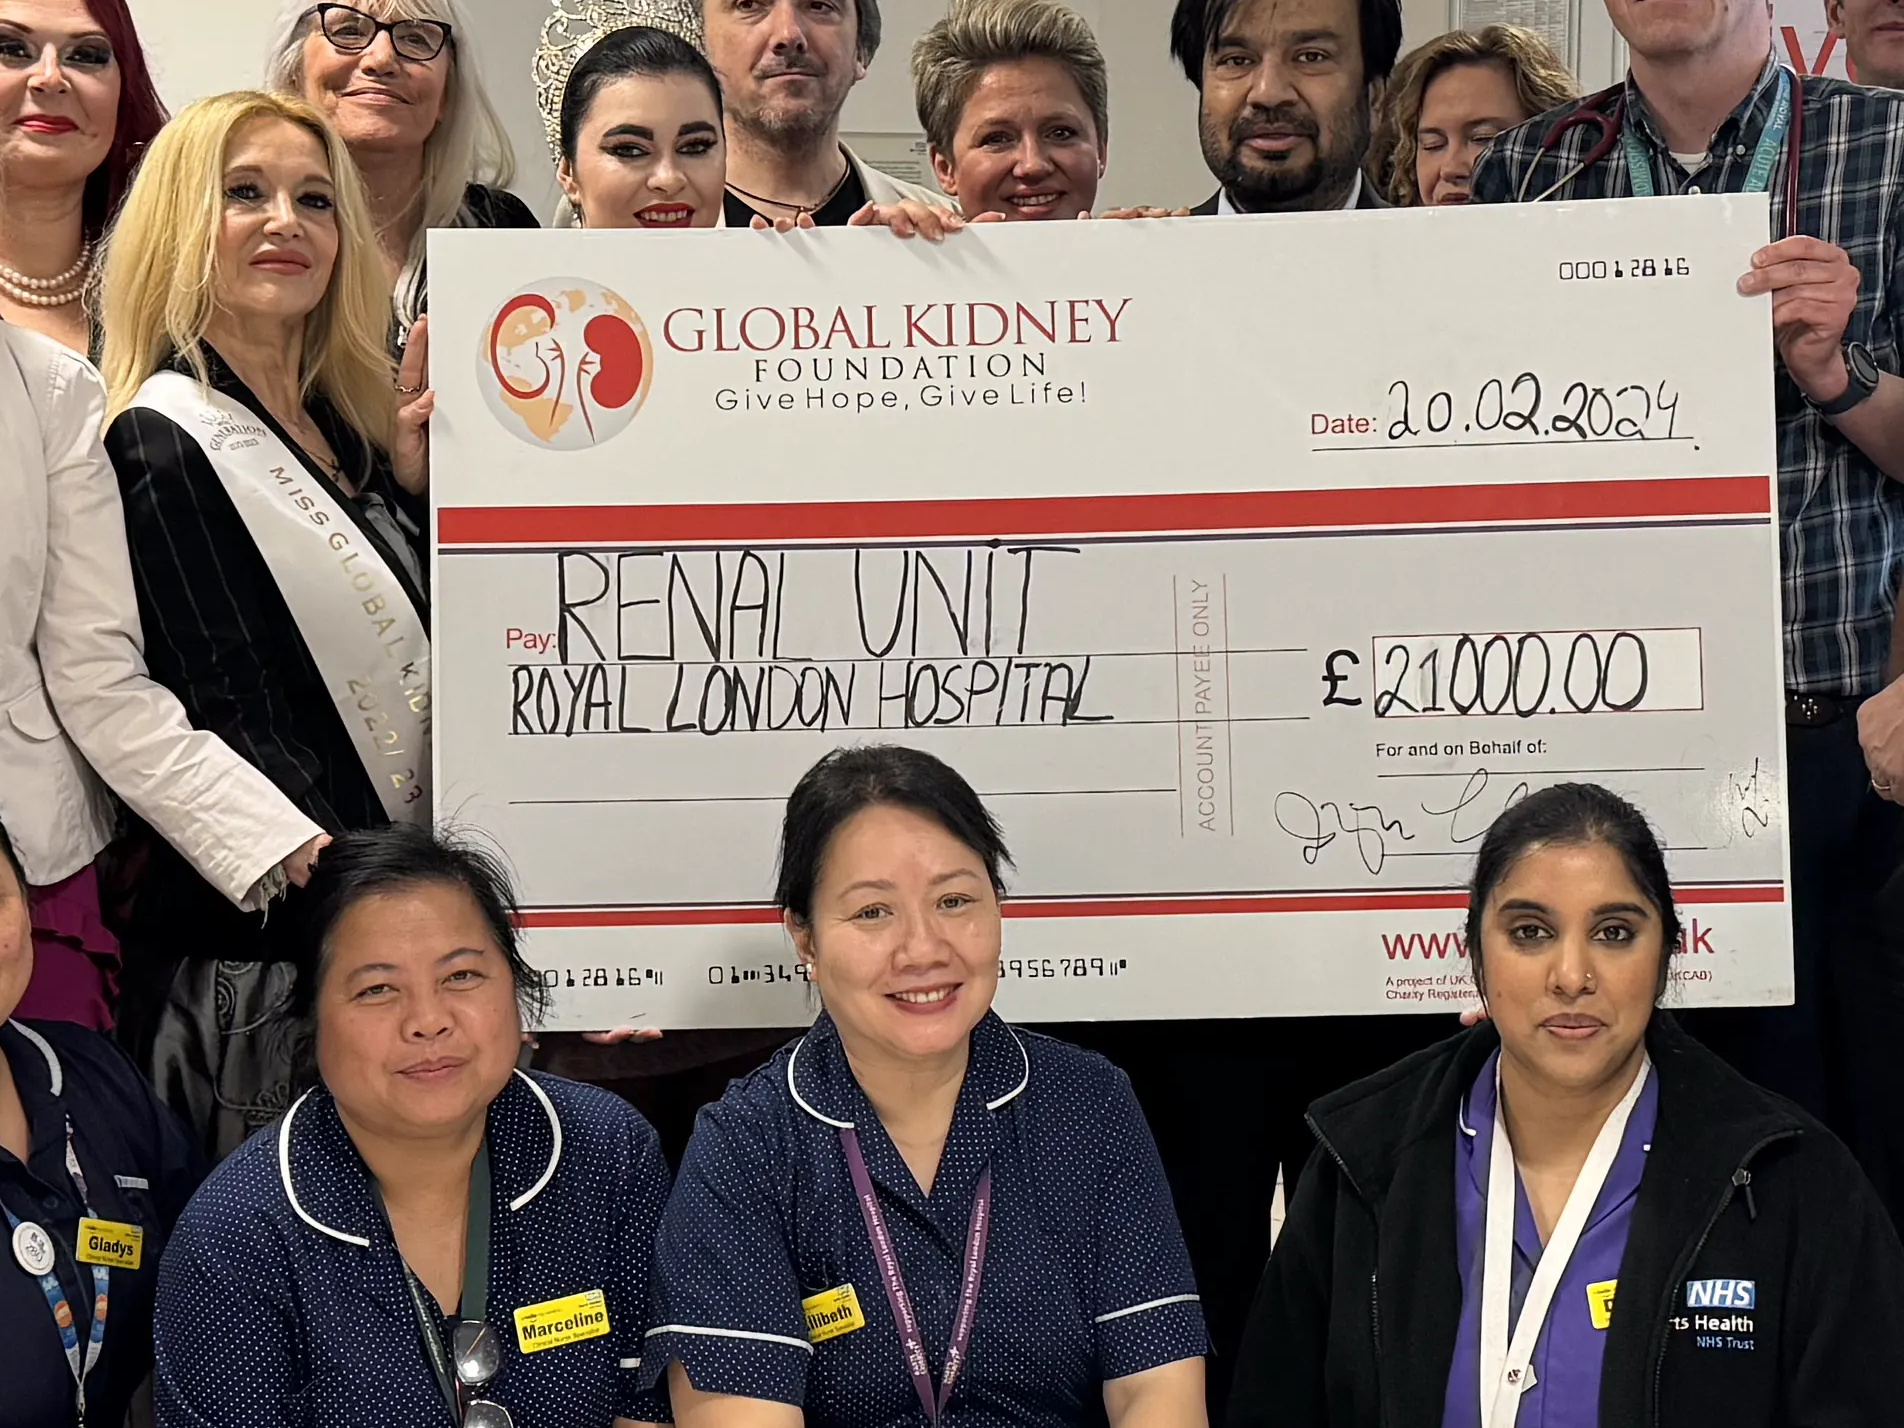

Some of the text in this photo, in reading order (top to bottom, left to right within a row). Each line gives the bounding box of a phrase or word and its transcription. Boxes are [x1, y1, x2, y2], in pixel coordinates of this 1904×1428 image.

[1558, 258, 1690, 280] 00012816
[663, 298, 1133, 354] GLOBAL KIDNEY
[753, 352, 1048, 384] FOUNDATION
[714, 381, 1088, 414] Give Hope, Give Life!
[1386, 372, 1680, 440] 20.02.2024
[1310, 412, 1378, 436] Date:
[268, 465, 330, 528] MISS
[328, 532, 407, 660] GLOBAL
[557, 546, 1081, 663] RENAL UNIT
[504, 628, 557, 655] Pay:
[1322, 649, 1362, 706] £
[1375, 632, 1649, 717] 21000.00
[511, 655, 1114, 736] ROYAL LONDON HOSPITAL
[1192, 578, 1217, 832] ACCOUNT PAYEE ONLY
[1375, 742, 1403, 758] For
[1407, 741, 1440, 757] and
[1443, 744, 1464, 756] on
[1526, 740, 1548, 754] of:
[89, 1235, 134, 1259] Gladys
[1688, 1280, 1754, 1307] NHS
[521, 1311, 604, 1340] Marceline
[1695, 1315, 1754, 1333] Health
[1696, 1336, 1755, 1350] NHS Trust
